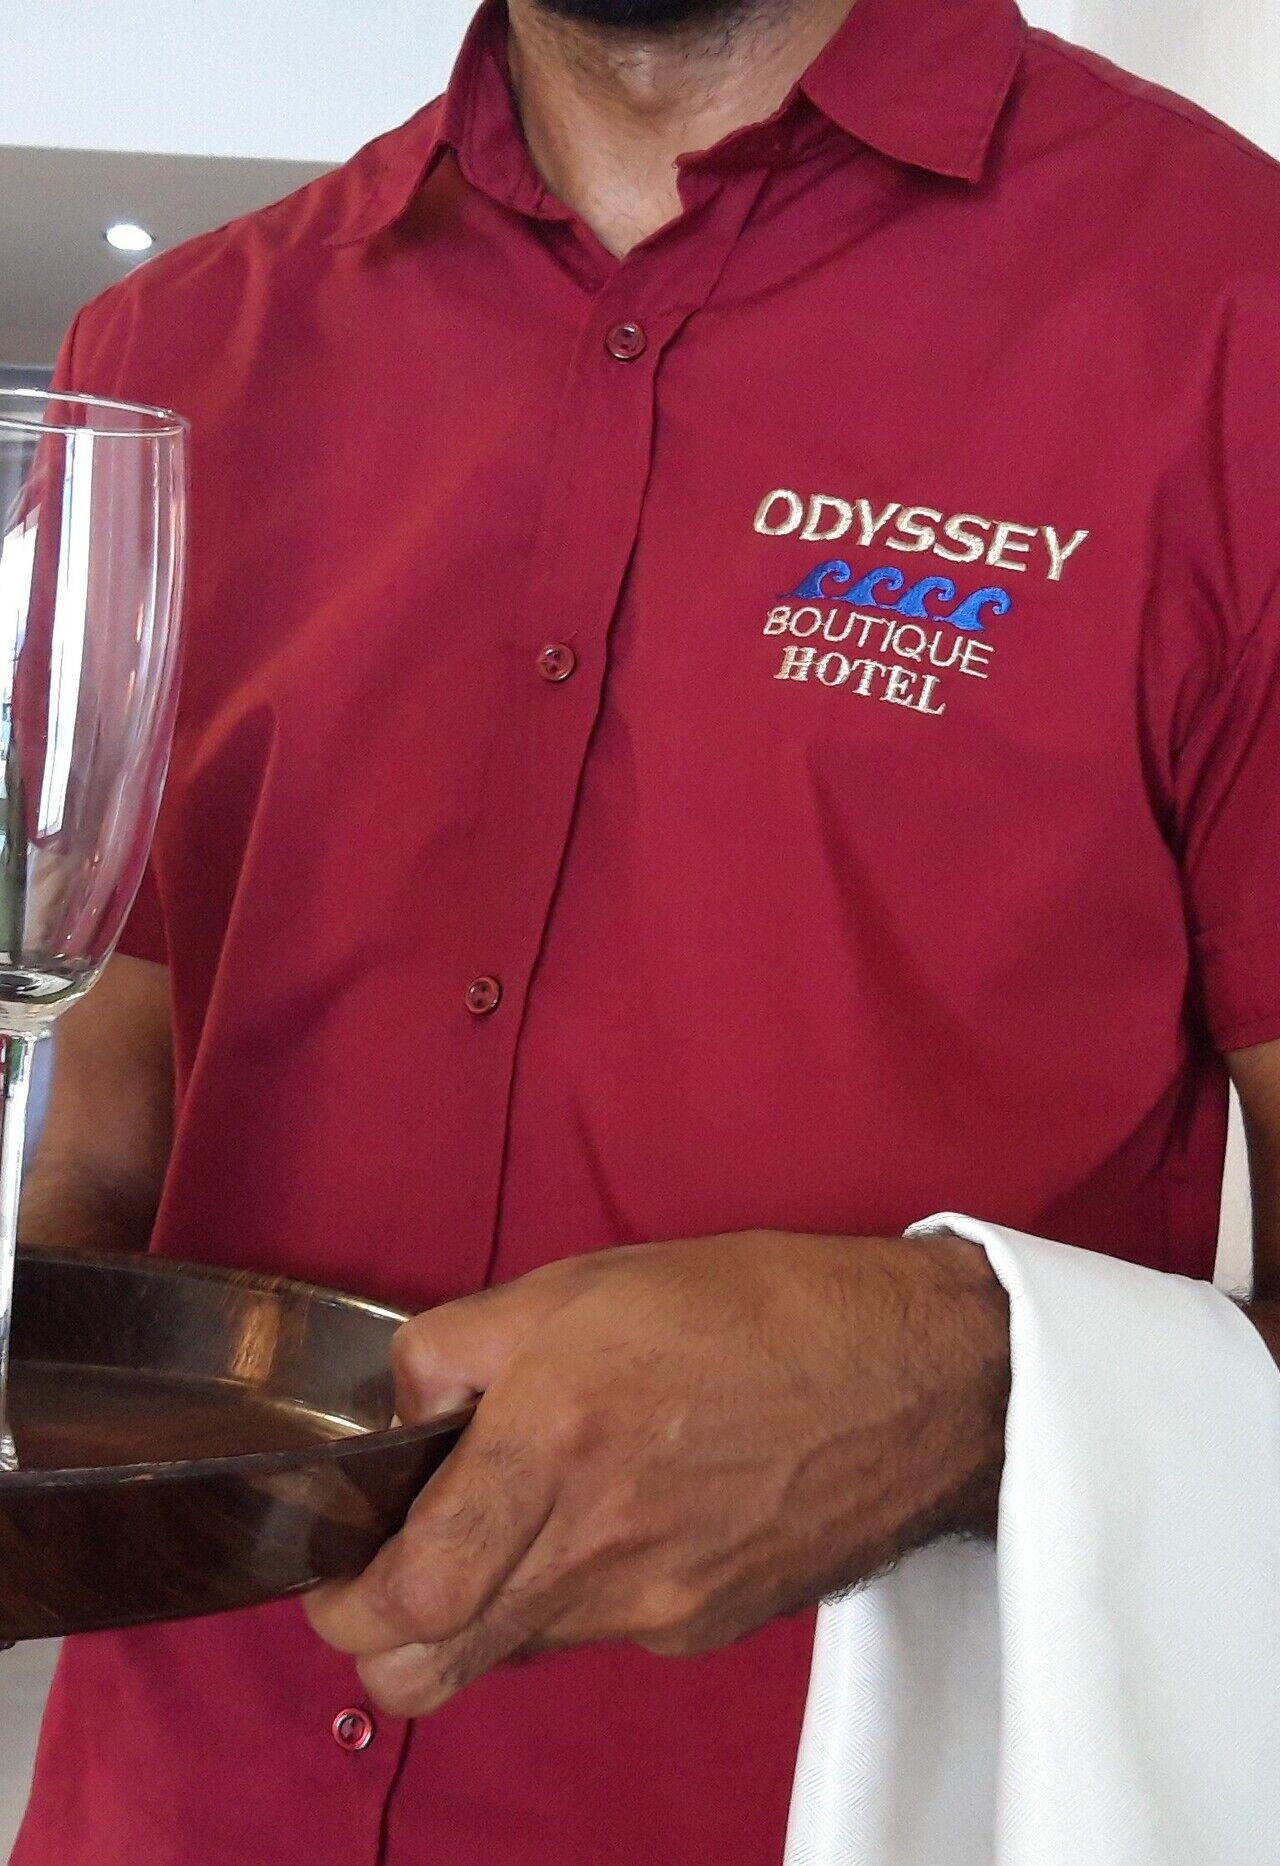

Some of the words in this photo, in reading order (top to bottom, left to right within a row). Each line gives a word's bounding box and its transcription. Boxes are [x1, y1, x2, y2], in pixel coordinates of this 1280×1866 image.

[752, 488, 1090, 582] ODYSSEY
[763, 605, 995, 679] BOUTIQUE
[773, 645, 947, 715] HOTEL
